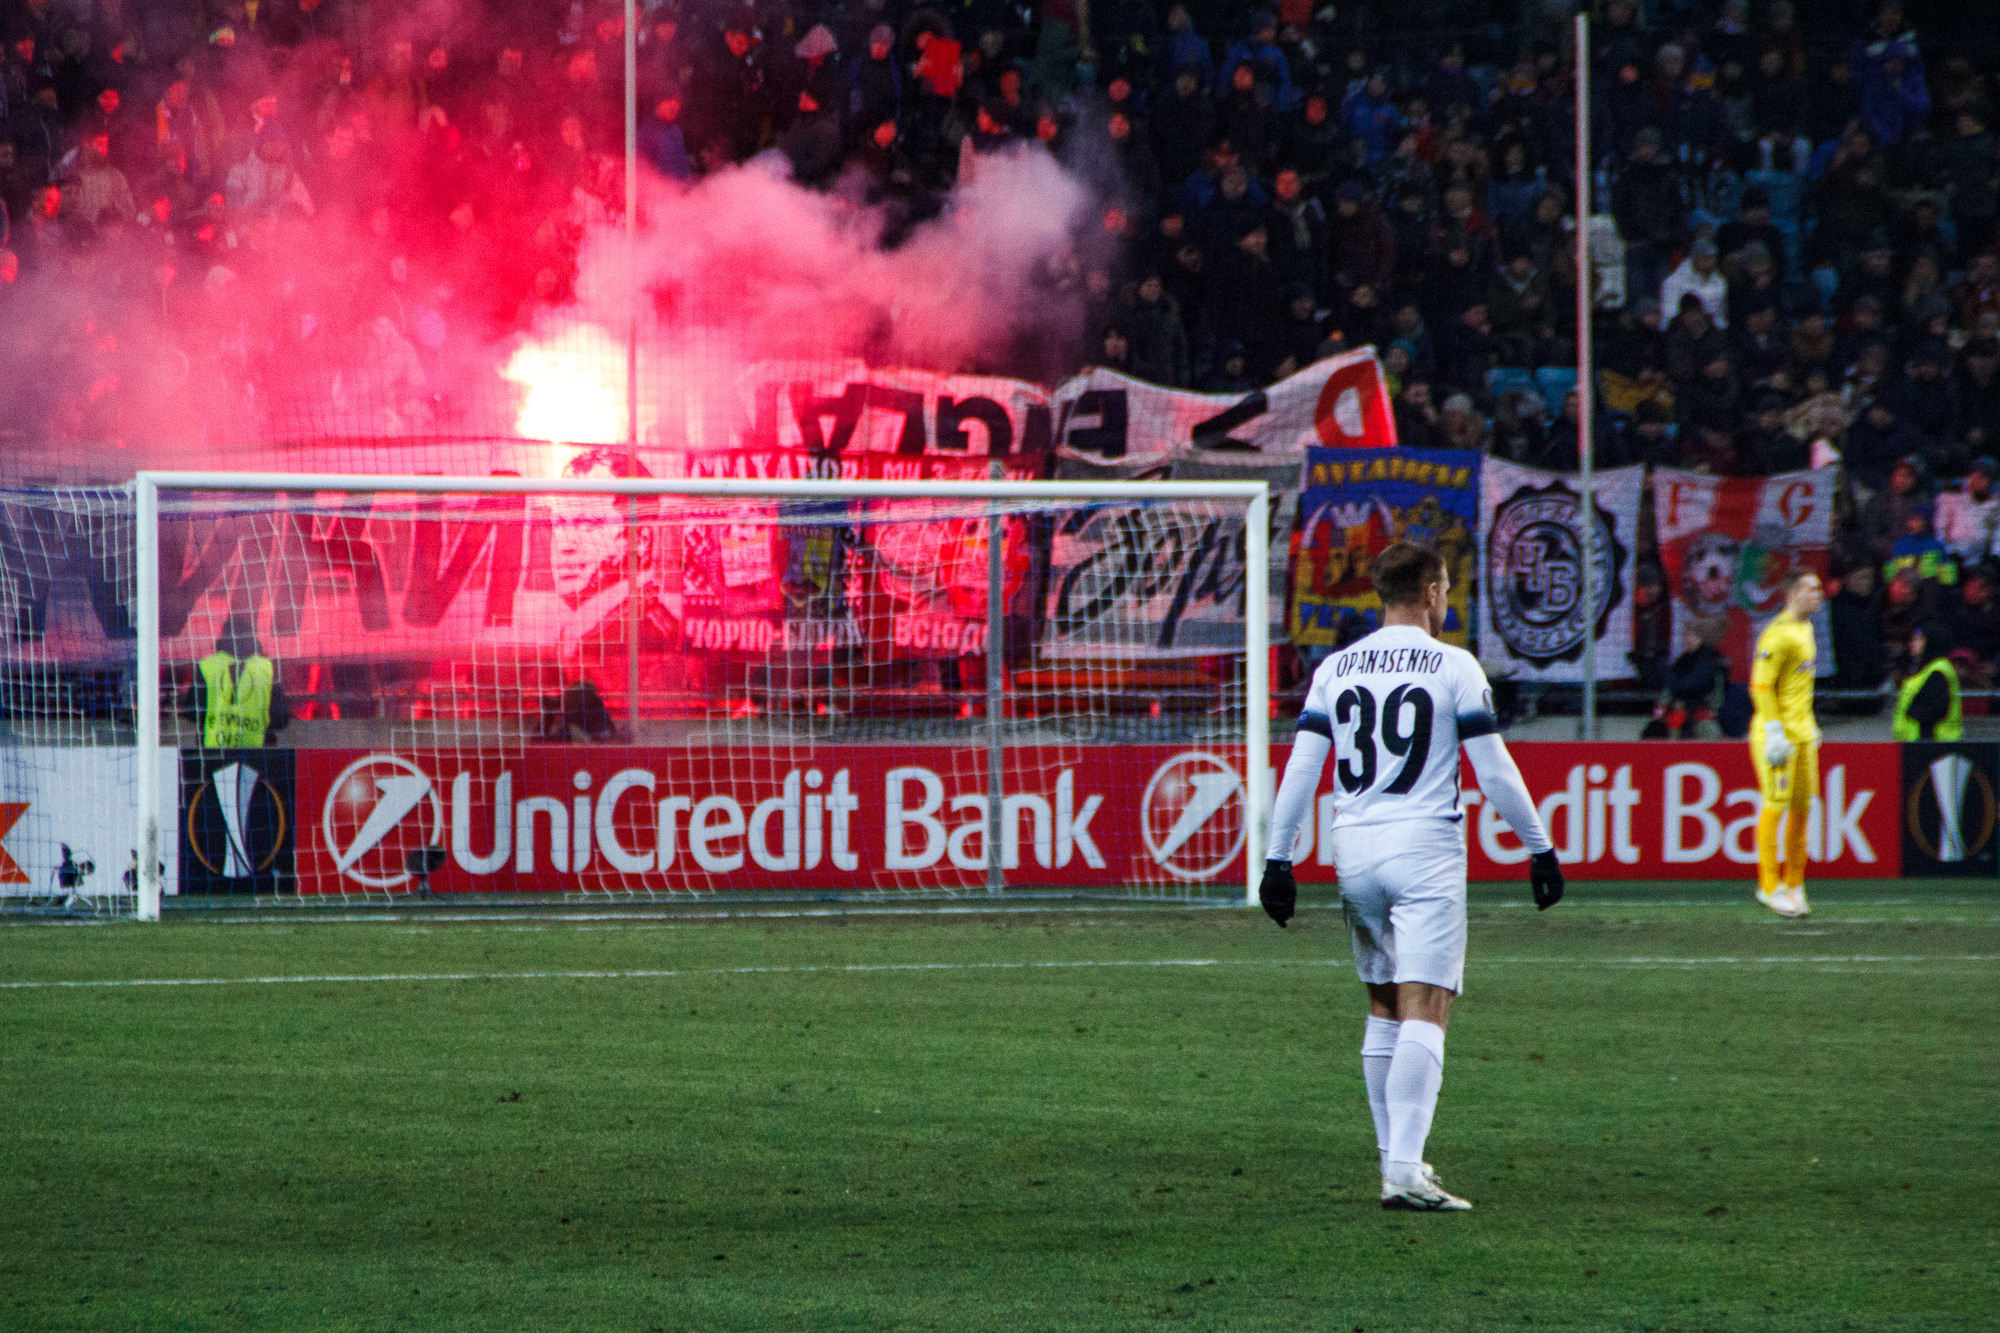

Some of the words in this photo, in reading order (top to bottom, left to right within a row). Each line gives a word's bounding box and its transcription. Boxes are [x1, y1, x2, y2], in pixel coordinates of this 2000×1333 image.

[1336, 648, 1443, 677] OPANASENKO
[1336, 683, 1434, 797] 39
[452, 768, 859, 875] UniCredit
[885, 767, 1106, 871] Bank
